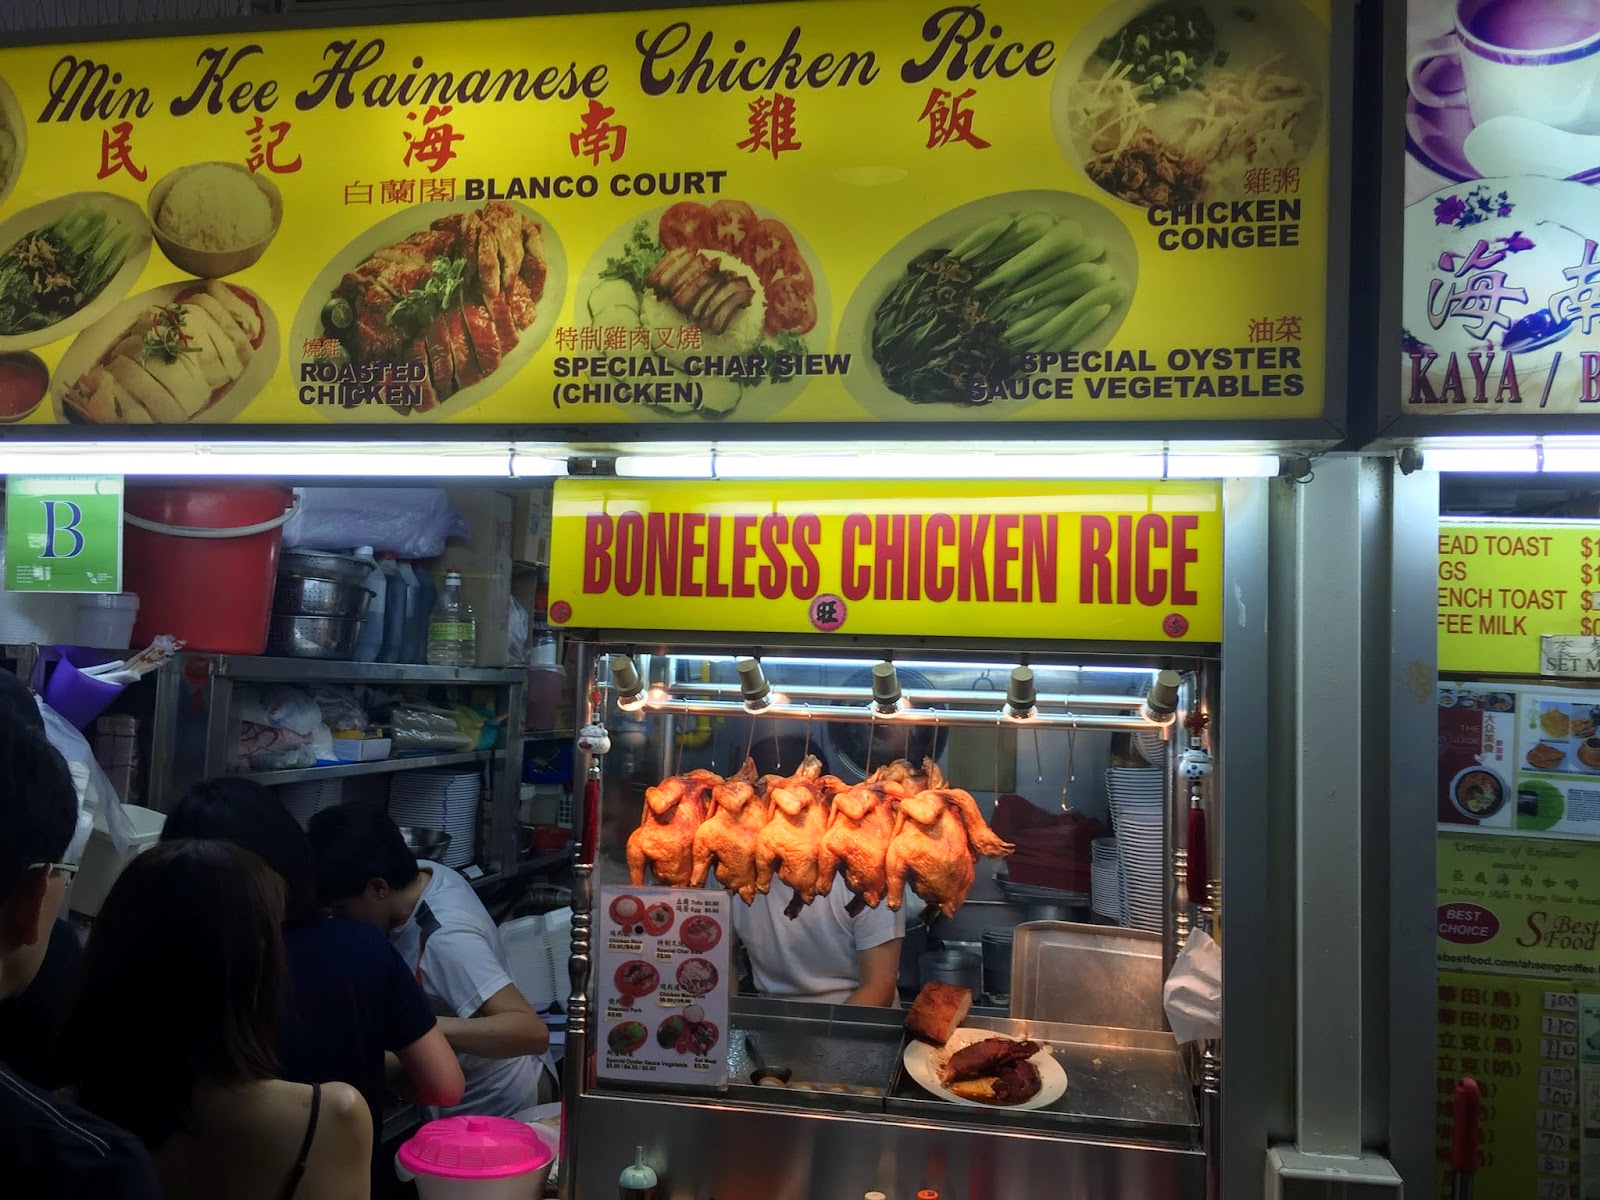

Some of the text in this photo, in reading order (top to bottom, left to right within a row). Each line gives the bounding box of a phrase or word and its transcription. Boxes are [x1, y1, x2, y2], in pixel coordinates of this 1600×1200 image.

[37, 3, 1055, 123] Min Kee Hainanese Chicken Rice
[344, 170, 728, 205] 白蘭閣 BLANCO COURT
[1147, 199, 1301, 227] CHICKEN
[1157, 224, 1300, 251] CONGEE
[300, 361, 428, 383] ROASTED
[553, 352, 852, 378] SPECIAL CHAR SIEW
[1022, 347, 1302, 373] SPECIAL OYSTER
[968, 374, 1305, 402] SAUCE VEGETABLES
[1409, 352, 1522, 404] KAYA
[298, 384, 424, 406] CHICKEN
[553, 382, 704, 409] (CHICKEN)
[38, 500, 85, 558] B
[582, 511, 1199, 606] BONELESS CHICKEN RICE
[1484, 536, 1553, 557] TOAST
[1498, 588, 1568, 610] TOAST
[1479, 615, 1527, 636] MILK
[1546, 657, 1580, 673] SET
[1450, 736, 1481, 745] GUIDE
[1459, 724, 1481, 733] THE
[1446, 909, 1482, 922] BEST
[1438, 923, 1489, 937] CHOICE
[1543, 930, 1597, 951] Food
